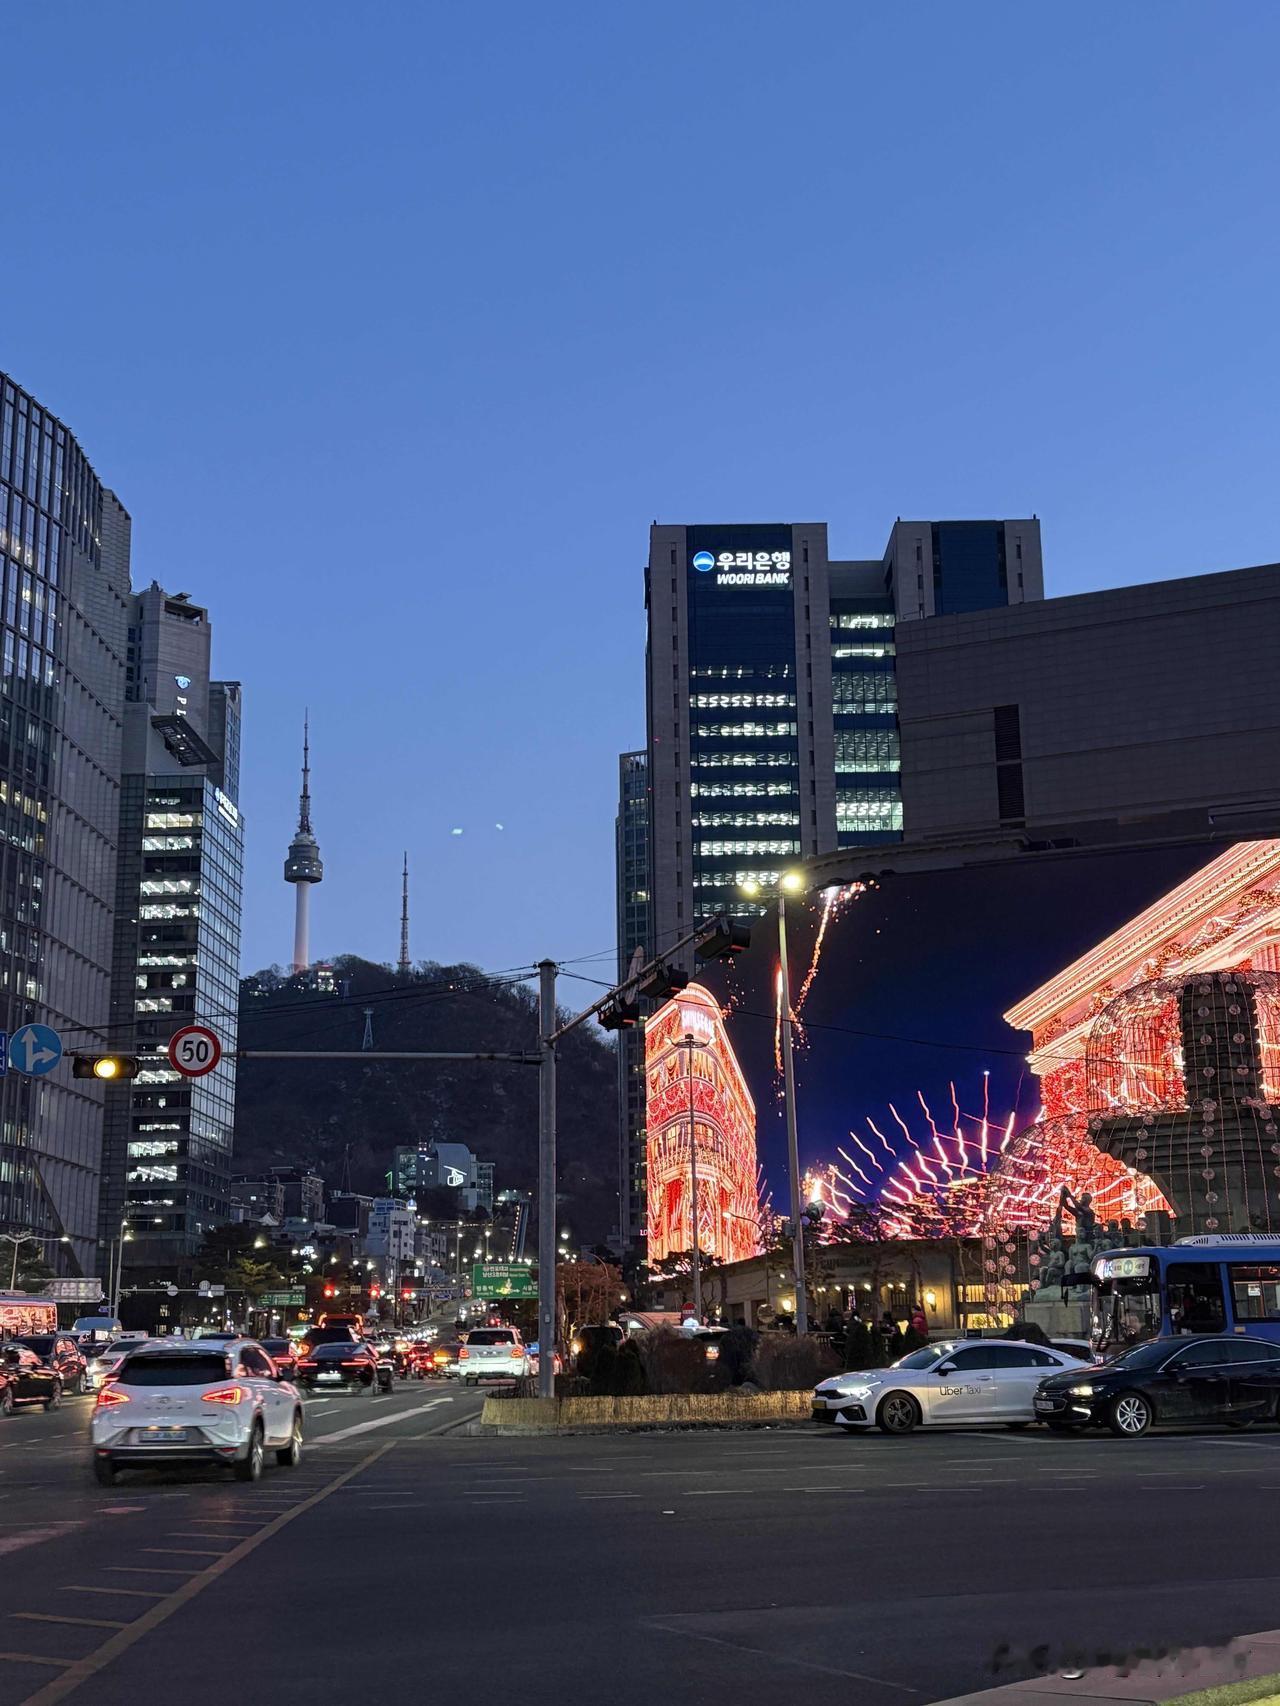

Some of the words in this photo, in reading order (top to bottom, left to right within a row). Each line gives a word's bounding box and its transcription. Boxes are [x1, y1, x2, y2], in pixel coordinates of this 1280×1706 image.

[716, 551, 791, 570] 우리은행
[717, 573, 754, 585] WOORI
[755, 572, 790, 584] BANK
[182, 1040, 209, 1063] 50
[939, 1385, 963, 1396] Uber
[964, 1384, 982, 1395] Taxi
